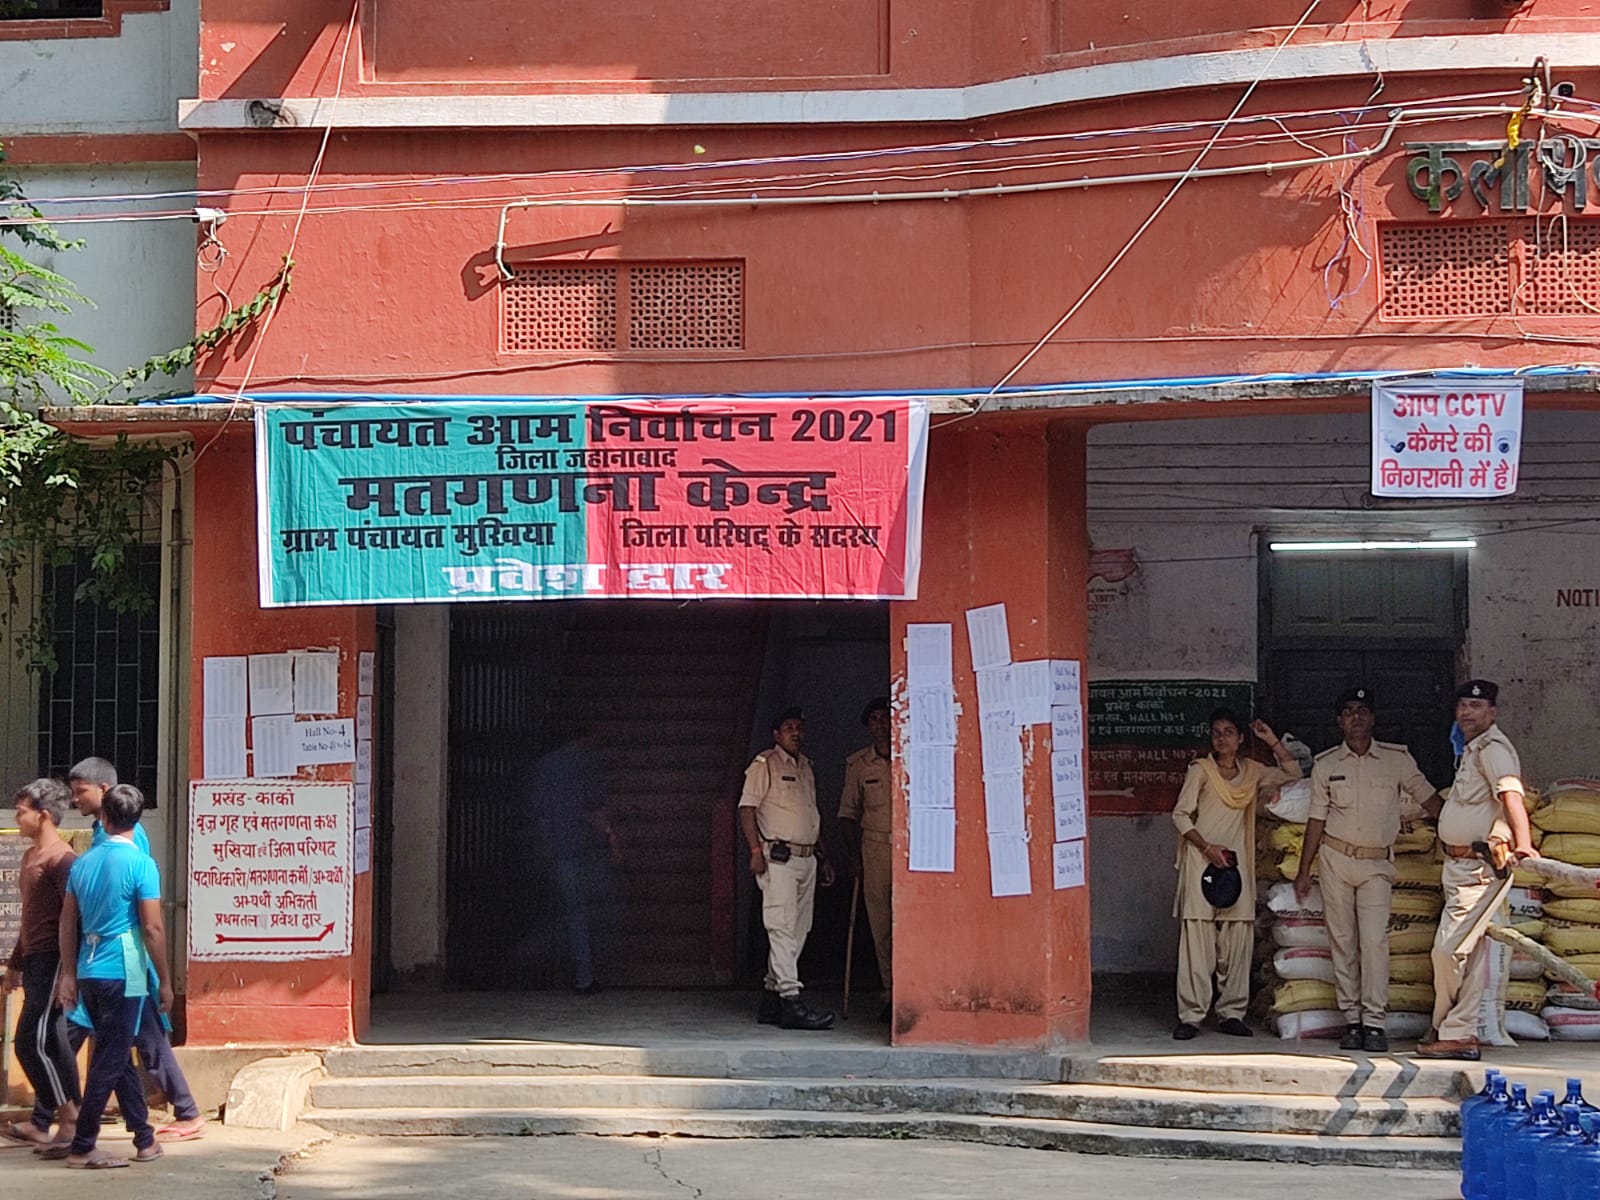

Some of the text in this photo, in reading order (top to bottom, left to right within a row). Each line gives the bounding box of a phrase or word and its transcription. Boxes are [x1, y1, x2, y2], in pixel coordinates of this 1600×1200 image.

[1536, 138, 1600, 209] भ
[1393, 393, 1506, 417] आप CCTV
[280, 404, 896, 449] पंचायत आम निर्वाचन 2021
[1407, 422, 1493, 453] कैमरे की
[497, 446, 678, 470] जिला जहानाबाद
[1381, 458, 1464, 488] निगरानी
[1469, 459, 1491, 488] में
[338, 458, 836, 517] मतगणना केन्द्र
[280, 517, 557, 556] ग्राम पंचायत मुखिया
[620, 518, 688, 548] जिला
[776, 518, 804, 548] के
[808, 524, 882, 549] सदस्य
[442, 558, 733, 595] प्रवेश द्वार
[1556, 588, 1600, 607] NOTI
[1129, 712, 1160, 722] HALL
[1138, 750, 1169, 761] HALL
[212, 788, 247, 807] प्रखंड
[219, 814, 240, 835] गृह
[242, 810, 259, 833] एवं
[261, 815, 312, 832] मतगणना
[313, 814, 337, 831] कक्ष
[212, 839, 256, 862] मुखिया
[268, 838, 296, 859] जिला
[270, 910, 299, 928] प्रवेश
